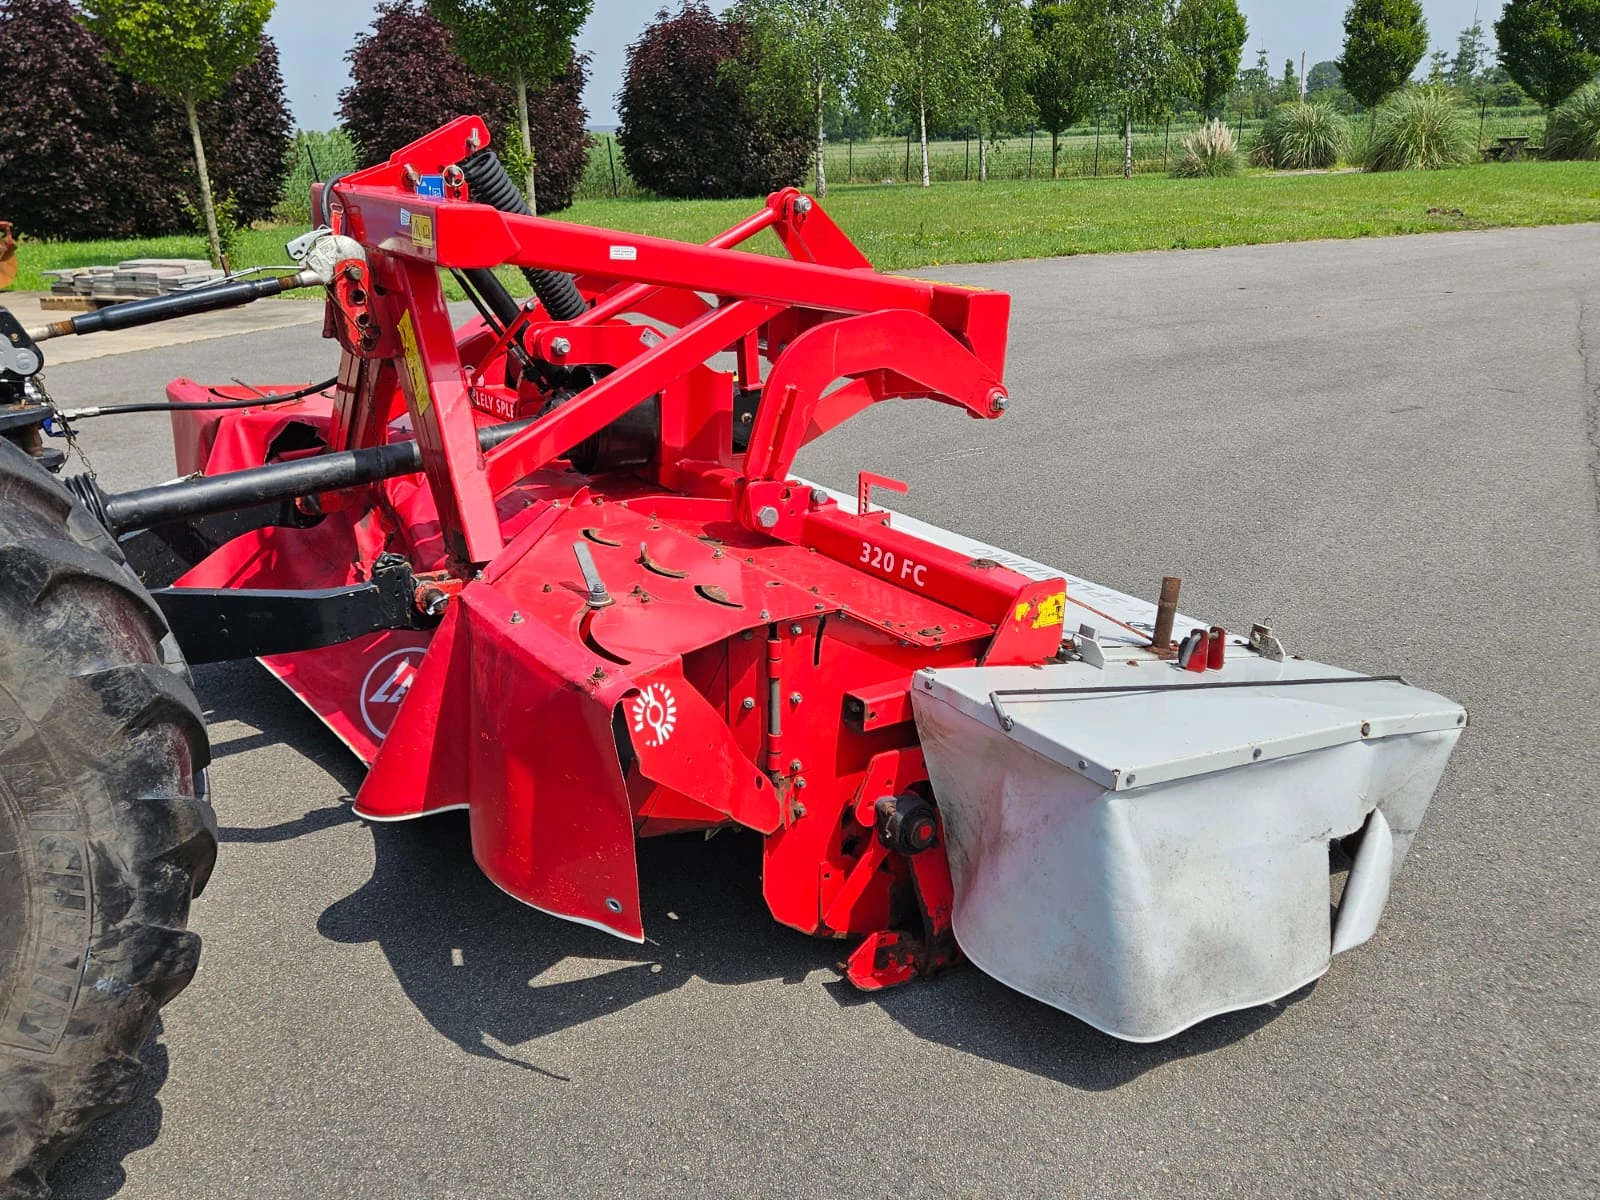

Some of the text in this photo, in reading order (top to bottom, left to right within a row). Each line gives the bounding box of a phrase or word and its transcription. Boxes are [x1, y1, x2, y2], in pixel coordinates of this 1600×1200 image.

[475, 391, 493, 410] LELY
[860, 541, 927, 587] 320 FC
